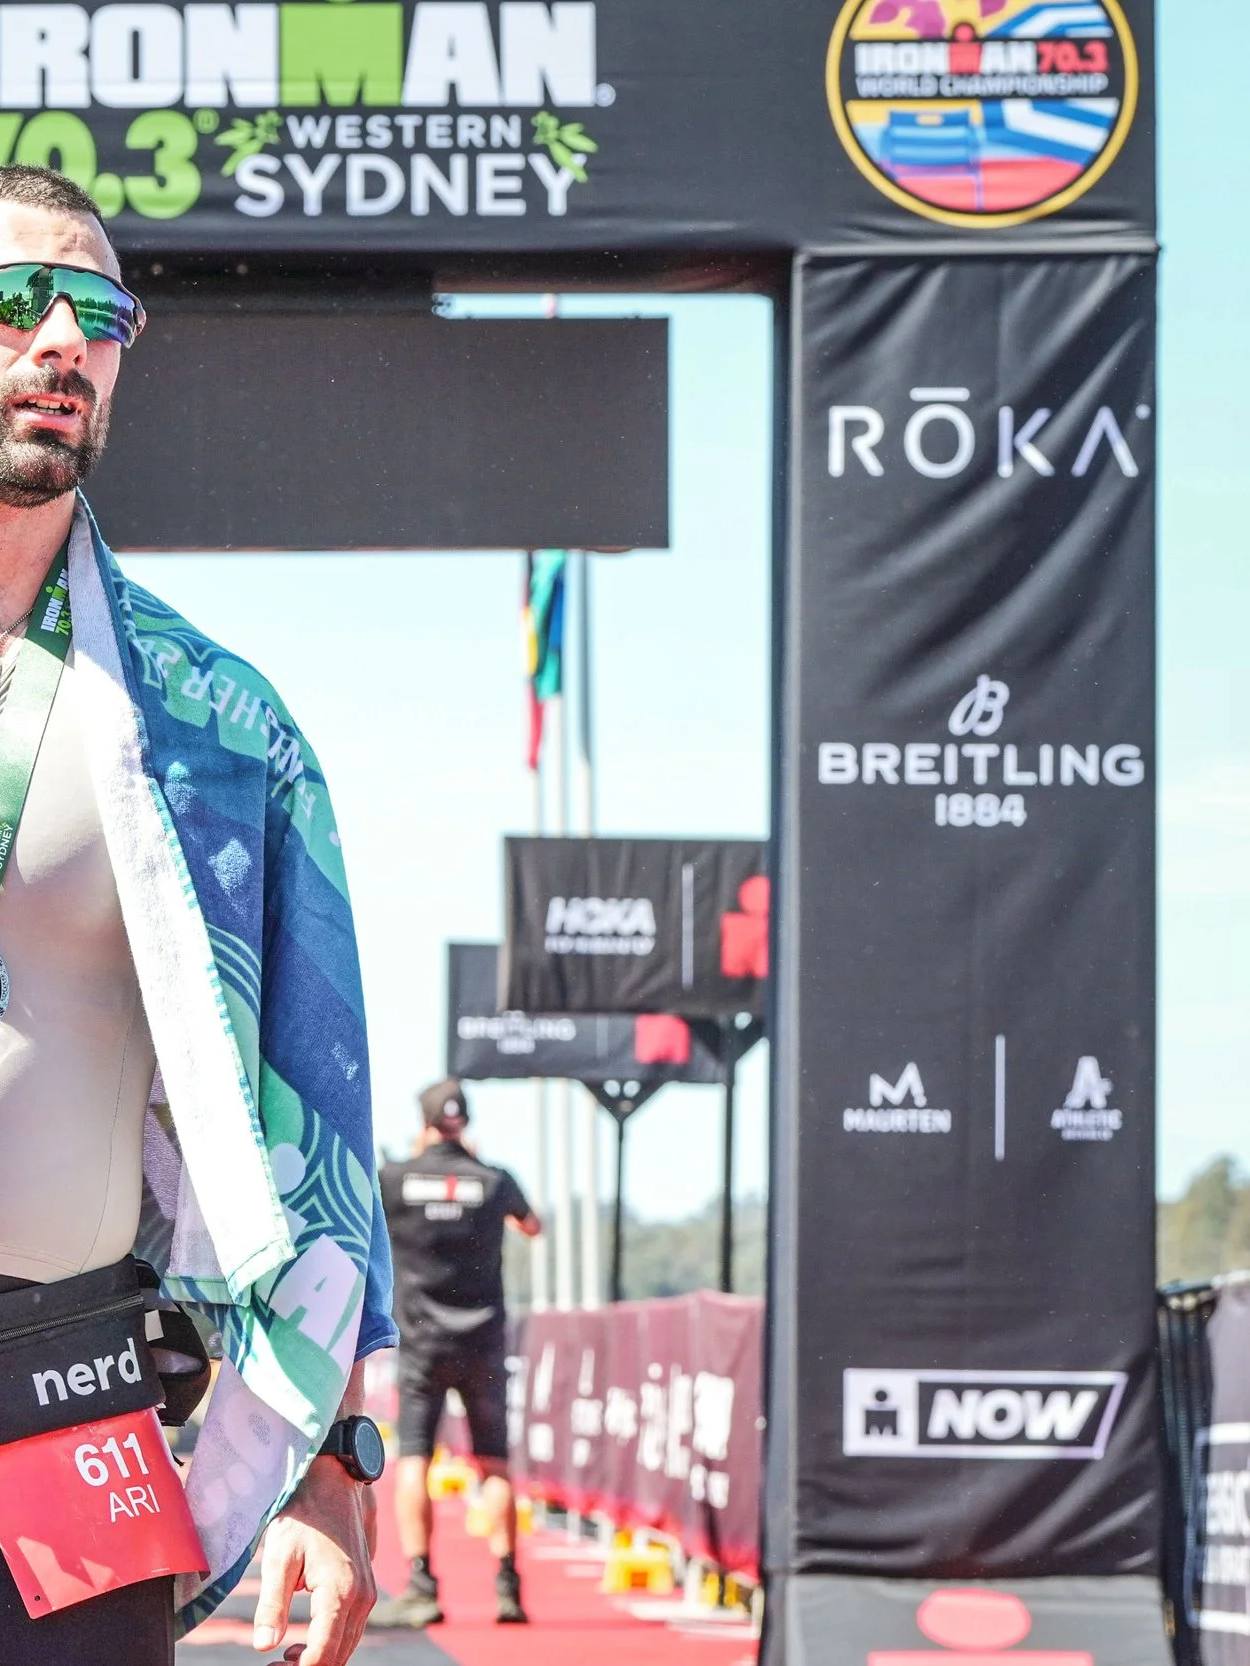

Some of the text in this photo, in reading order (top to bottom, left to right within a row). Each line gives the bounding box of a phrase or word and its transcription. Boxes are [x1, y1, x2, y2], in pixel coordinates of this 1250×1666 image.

[1037, 40, 1109, 74] 70.3
[855, 72, 1109, 98] WORLD CHAMPIONSHIP
[285, 114, 522, 149] WESTERN
[234, 153, 587, 218] SYDNEY
[818, 742, 1145, 786] BREITLING
[934, 793, 1028, 828] 1884
[32, 1337, 143, 1406] nerd
[927, 1389, 1099, 1440] NOW
[74, 1432, 149, 1487] 611
[109, 1484, 161, 1523] ARI
